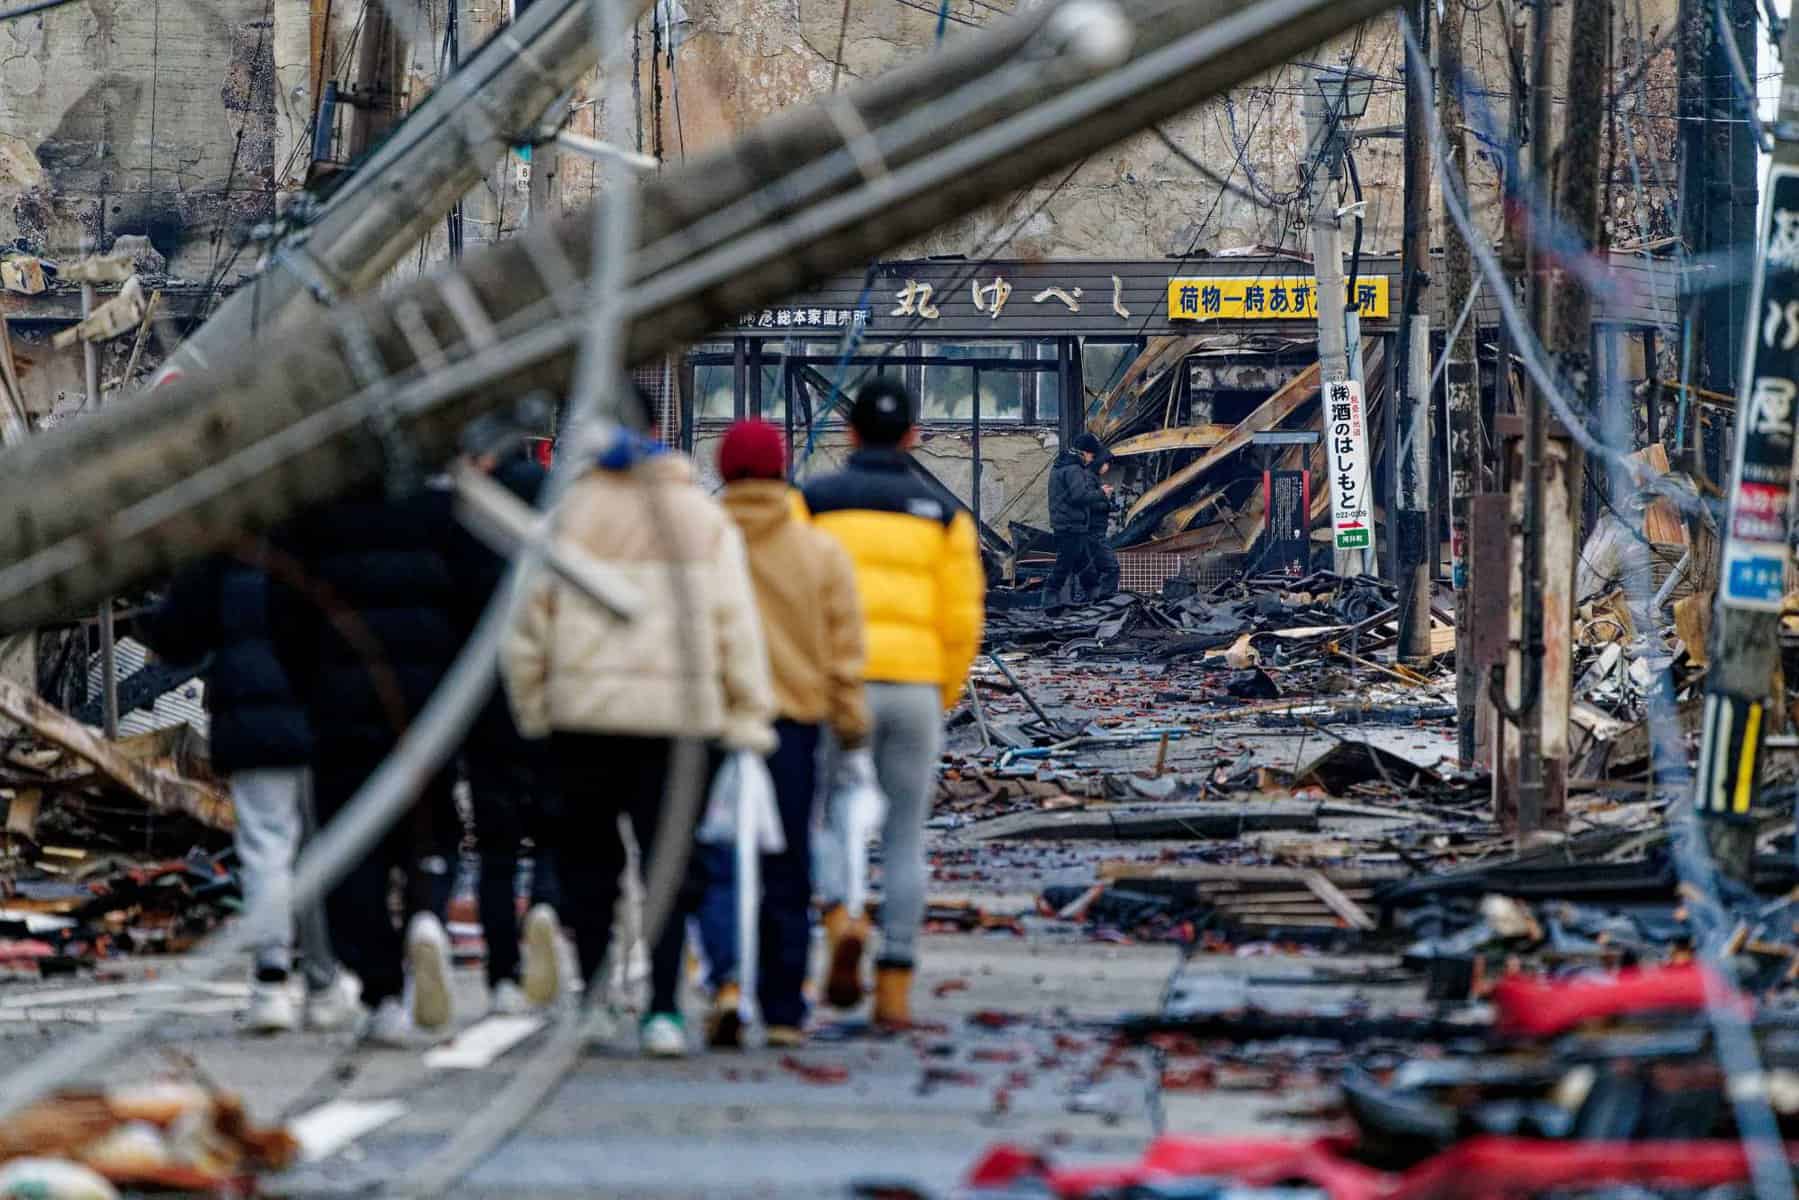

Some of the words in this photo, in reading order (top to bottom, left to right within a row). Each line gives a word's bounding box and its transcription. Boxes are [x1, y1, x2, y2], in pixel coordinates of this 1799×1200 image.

[890, 272, 1131, 319] 丸ゆべし
[1180, 284, 1377, 313] 荷物一時あず所
